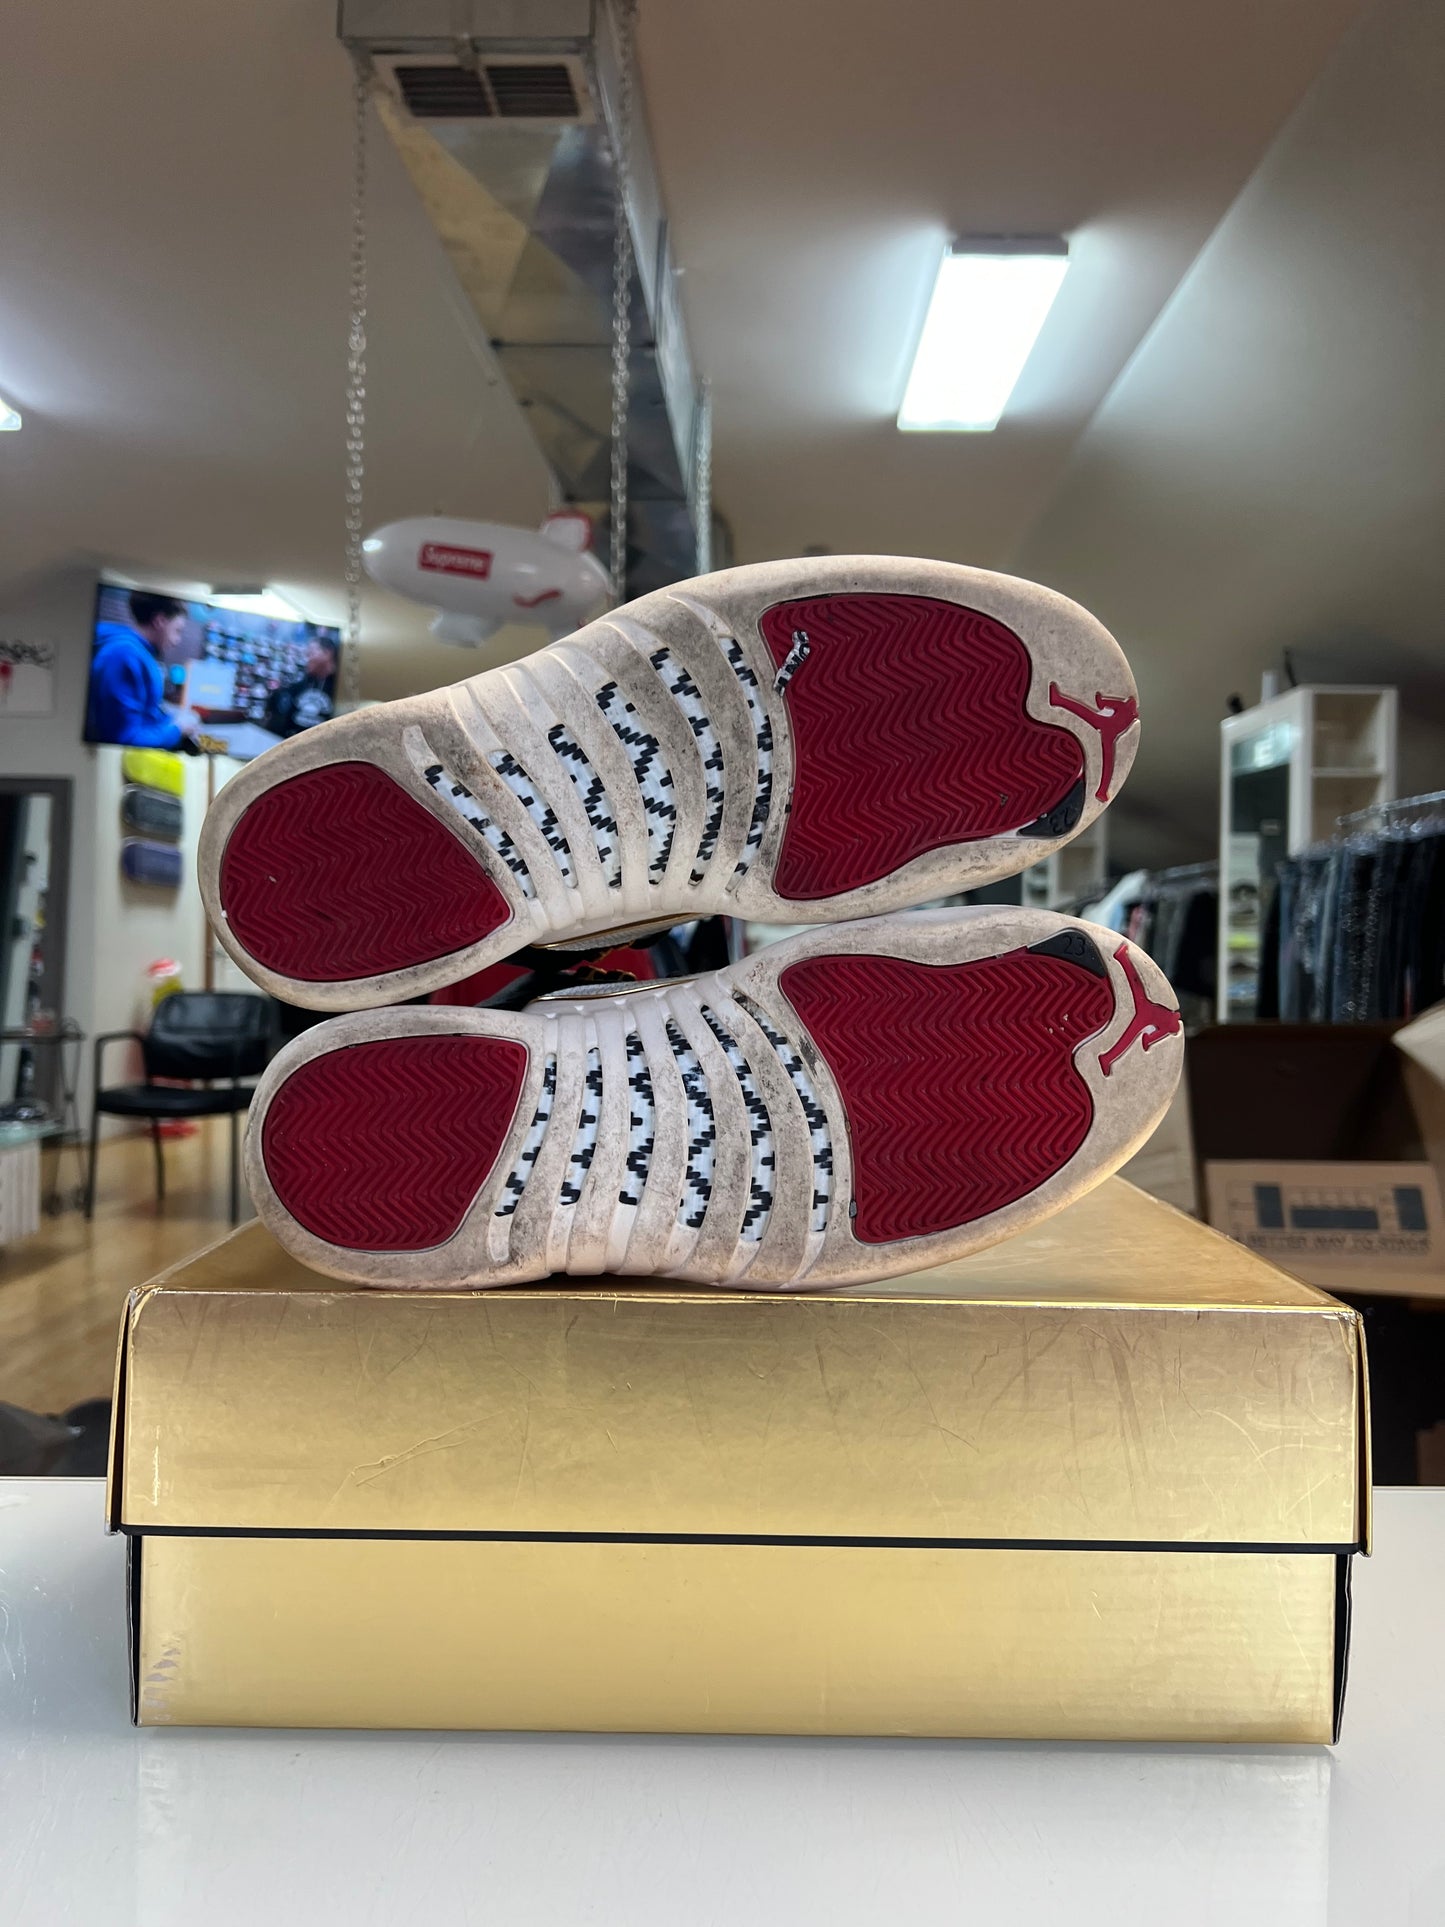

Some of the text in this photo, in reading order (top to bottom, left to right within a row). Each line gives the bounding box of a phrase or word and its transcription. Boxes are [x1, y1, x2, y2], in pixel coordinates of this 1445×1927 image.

[424, 546, 485, 573] Supreme
[1049, 807, 1075, 835] 23
[1063, 935, 1086, 957] 23
